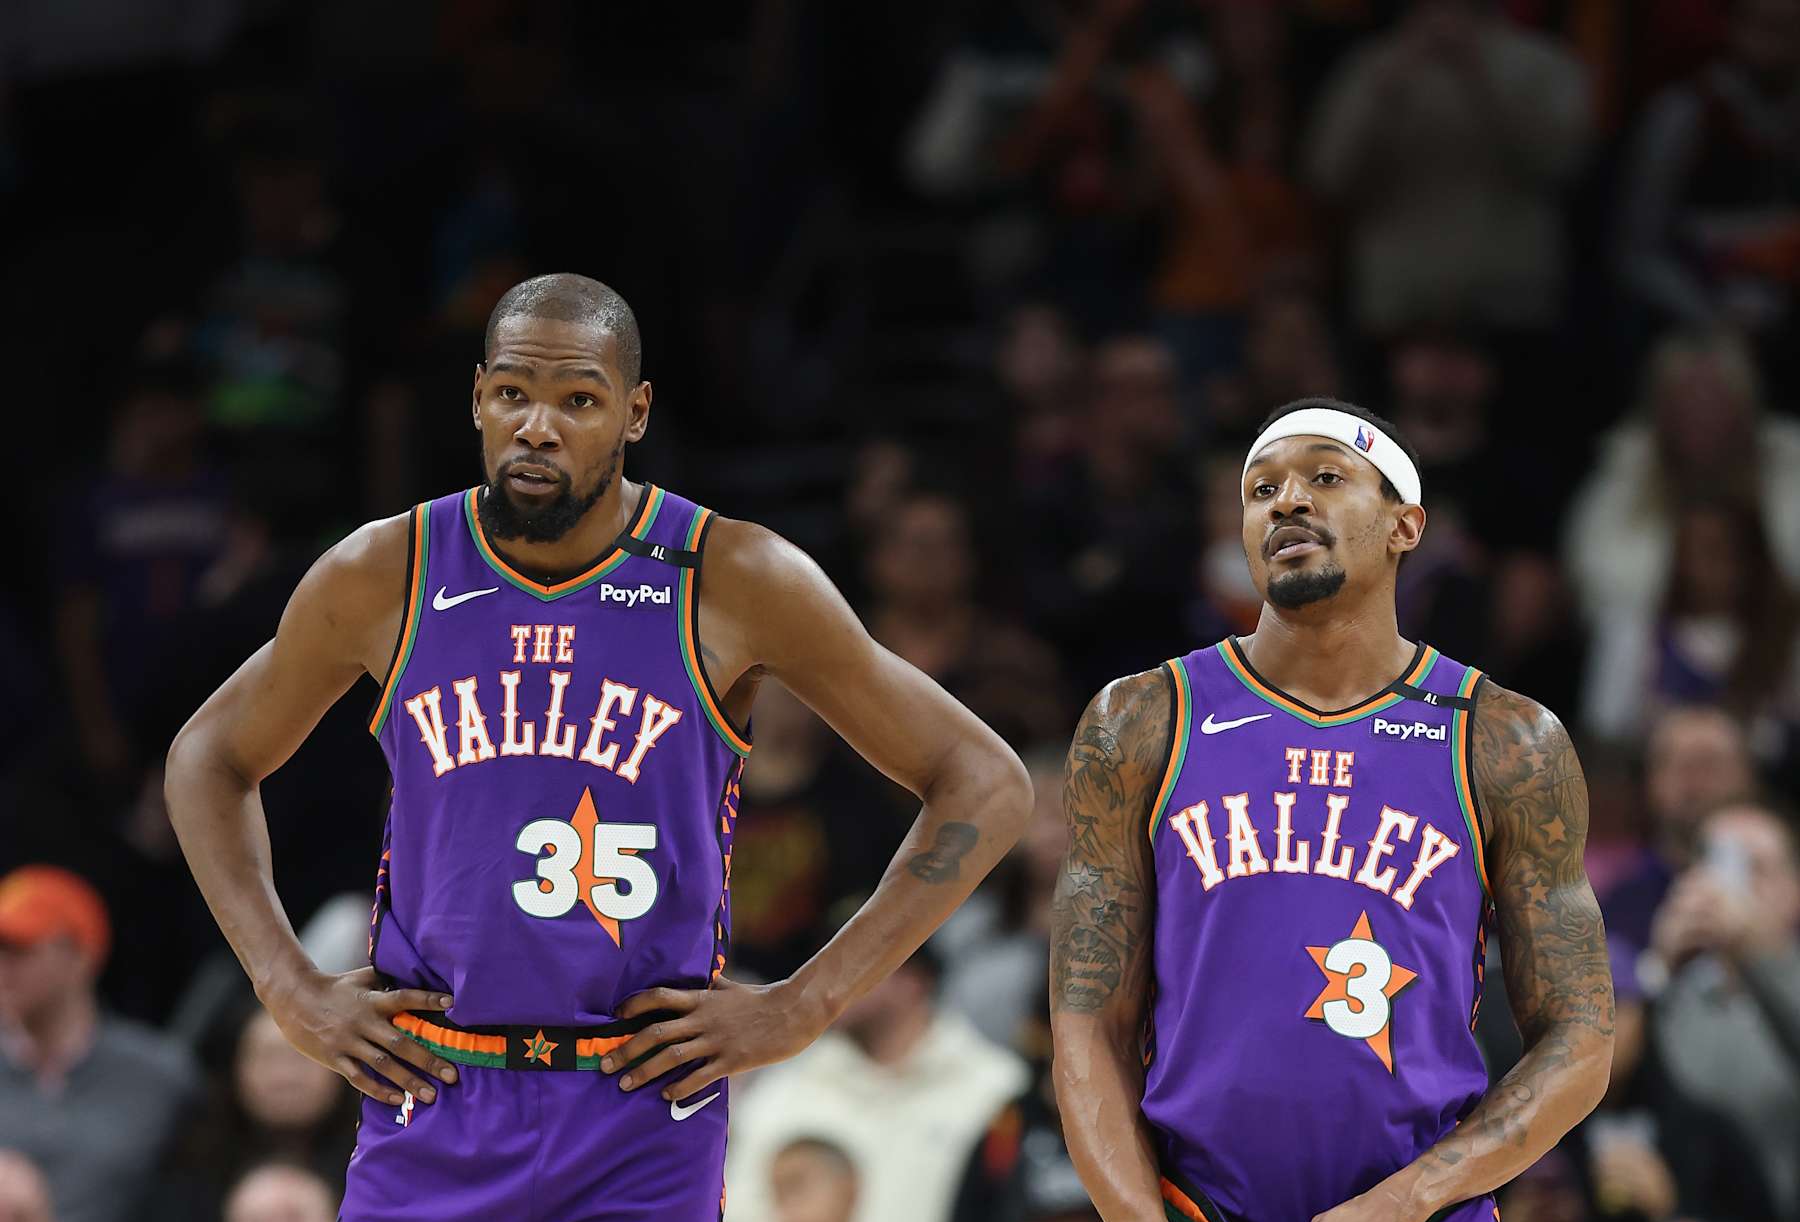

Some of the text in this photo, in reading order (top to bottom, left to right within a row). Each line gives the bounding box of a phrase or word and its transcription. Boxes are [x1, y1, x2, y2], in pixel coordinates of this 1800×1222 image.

[651, 545, 665, 560] AL
[600, 583, 671, 608] PayPal
[511, 624, 576, 664] THE
[1423, 692, 1438, 705] AL
[404, 669, 683, 785] VALLEY
[1373, 717, 1447, 741] PayPal
[1285, 747, 1355, 787] THE
[512, 818, 659, 921] 35
[1168, 791, 1461, 911] VALLEY
[1322, 937, 1393, 1039] 3
